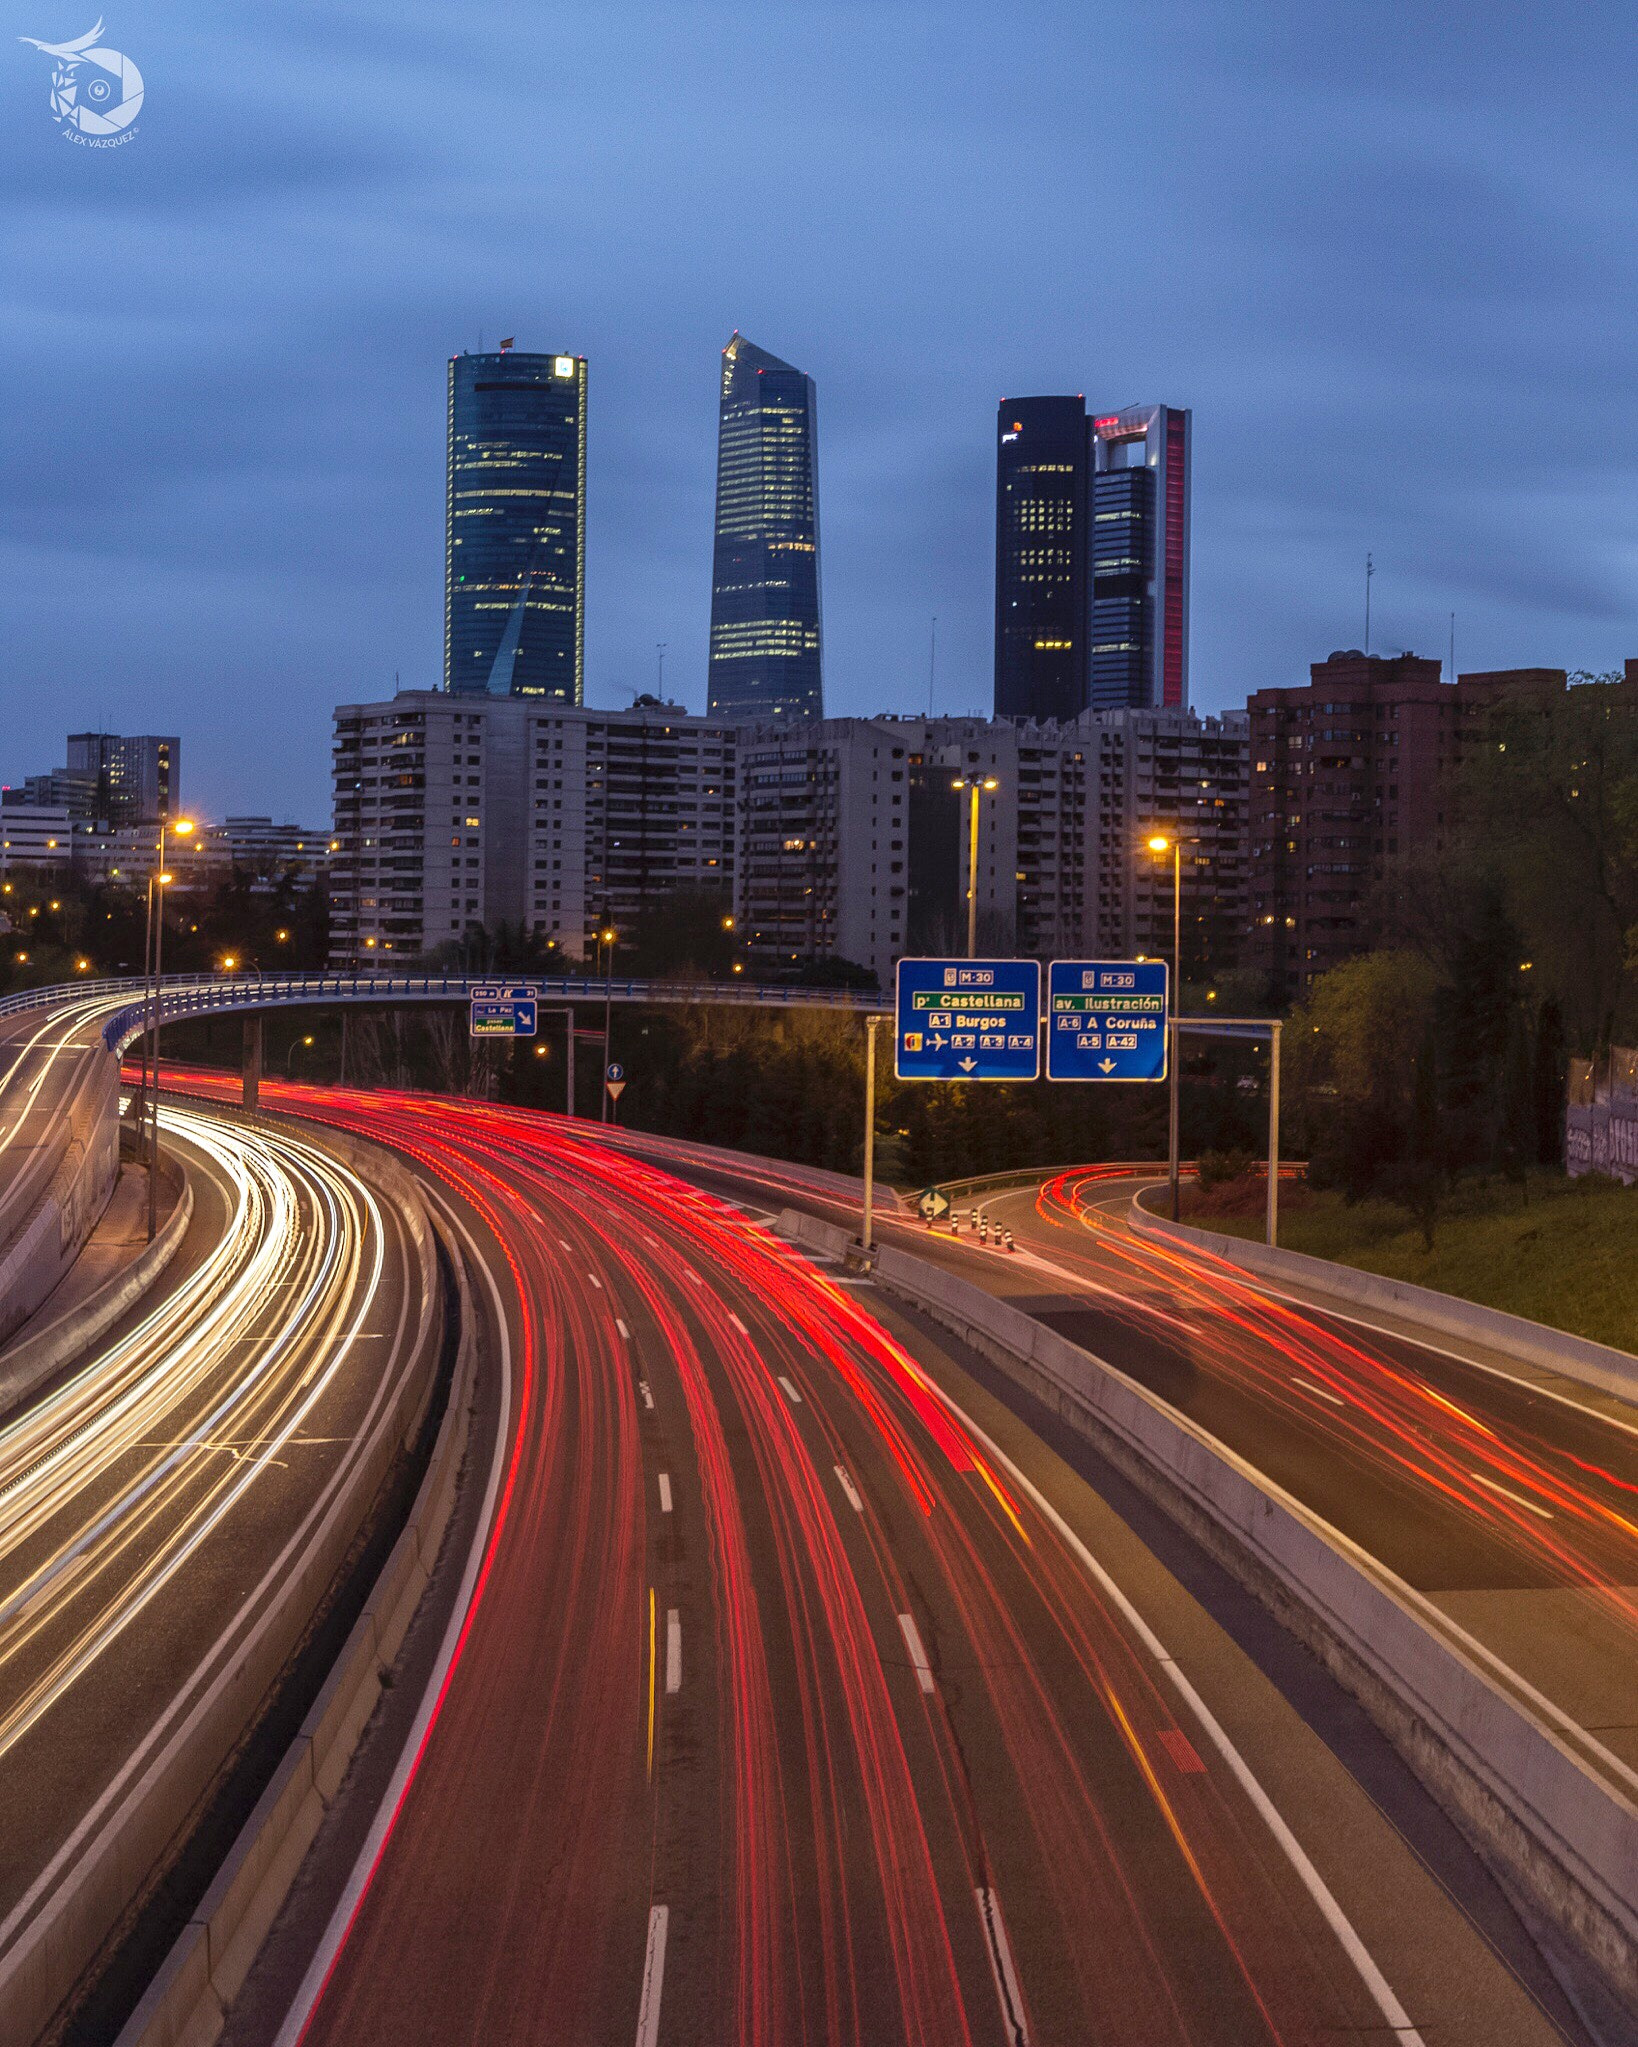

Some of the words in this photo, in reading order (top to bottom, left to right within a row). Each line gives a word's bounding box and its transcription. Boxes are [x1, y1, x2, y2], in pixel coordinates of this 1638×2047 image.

[940, 995, 1021, 1008] Castellana
[1055, 999, 1076, 1010] av.
[1085, 997, 1160, 1010] Ilustración
[931, 1014, 950, 1026] A-1
[956, 1014, 1007, 1031] Burgos
[1087, 1017, 1099, 1029] A
[1105, 1016, 1157, 1030] Coruña
